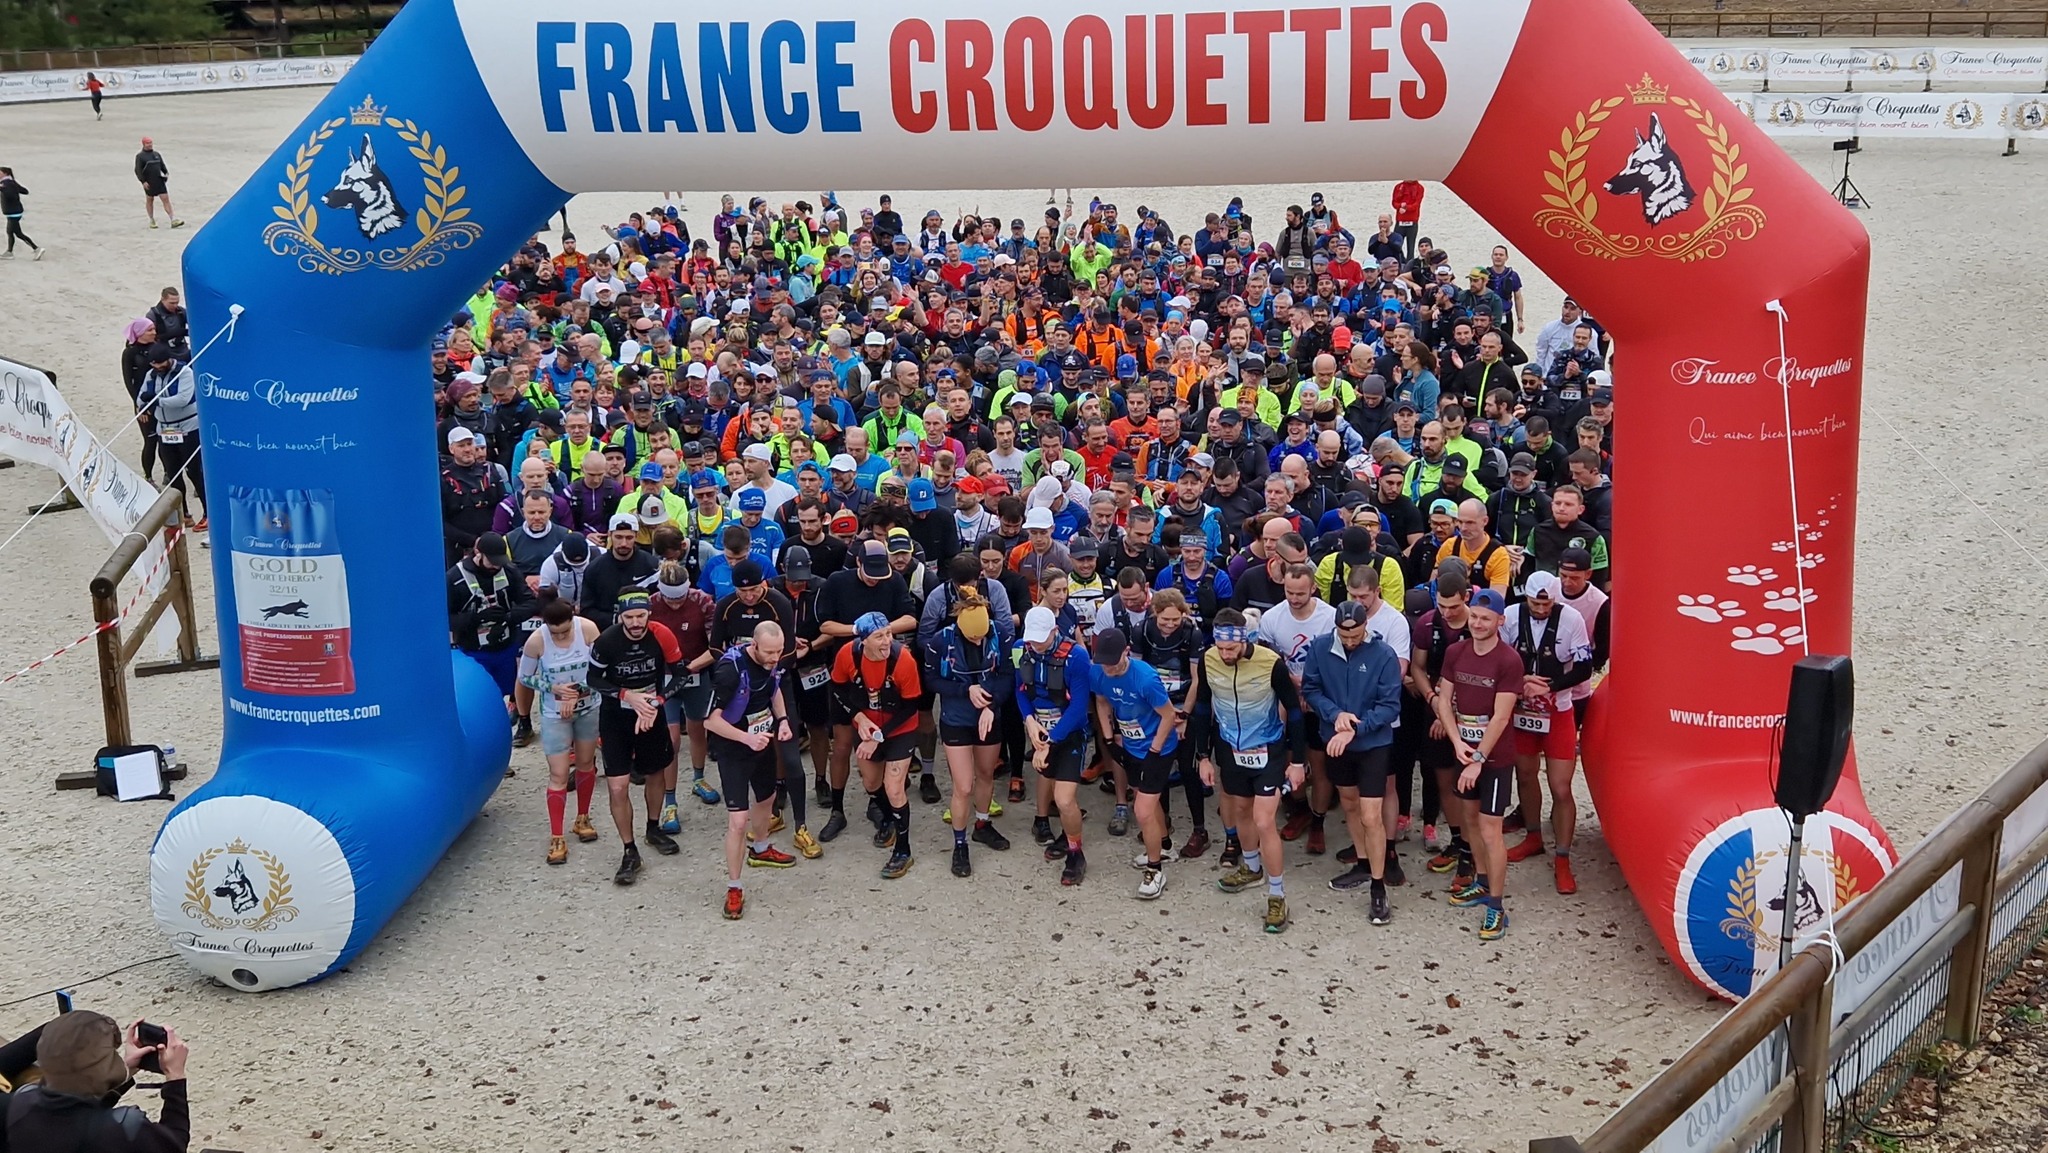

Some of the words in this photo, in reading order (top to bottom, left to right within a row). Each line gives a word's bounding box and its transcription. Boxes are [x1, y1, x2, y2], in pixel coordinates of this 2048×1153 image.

[1771, 51, 1811, 65] France
[1941, 51, 1984, 65] France
[536, 20, 863, 134] FRANCE
[889, 2, 1449, 134] CROQUETTES
[1809, 96, 1864, 115] France
[1867, 95, 1941, 119] Croquettes
[1671, 357, 1757, 386] France
[1763, 356, 1852, 388] Croquettes
[199, 372, 249, 402] France
[254, 378, 359, 411] Croquettes
[1689, 416, 1719, 445] Qui
[1724, 431, 1755, 440] aime
[1760, 422, 1787, 441] bien
[1792, 416, 1832, 438] nourrit
[1831, 413, 1847, 432] bien
[257, 433, 280, 450] bien
[1061, 526, 1072, 534] 77
[249, 557, 318, 573] GOLD
[250, 571, 276, 582] SPORT
[279, 573, 324, 583] ENERGY+
[269, 585, 298, 594] 32/16
[528, 620, 544, 628] 78
[808, 671, 827, 686] 922
[229, 697, 381, 727] www.francecroquettes.com
[753, 720, 771, 735] 965
[1519, 716, 1543, 730] 939
[1462, 727, 1484, 739] 899
[1240, 755, 1262, 766] 881
[177, 931, 230, 951] France
[233, 936, 315, 958] Croquettes
